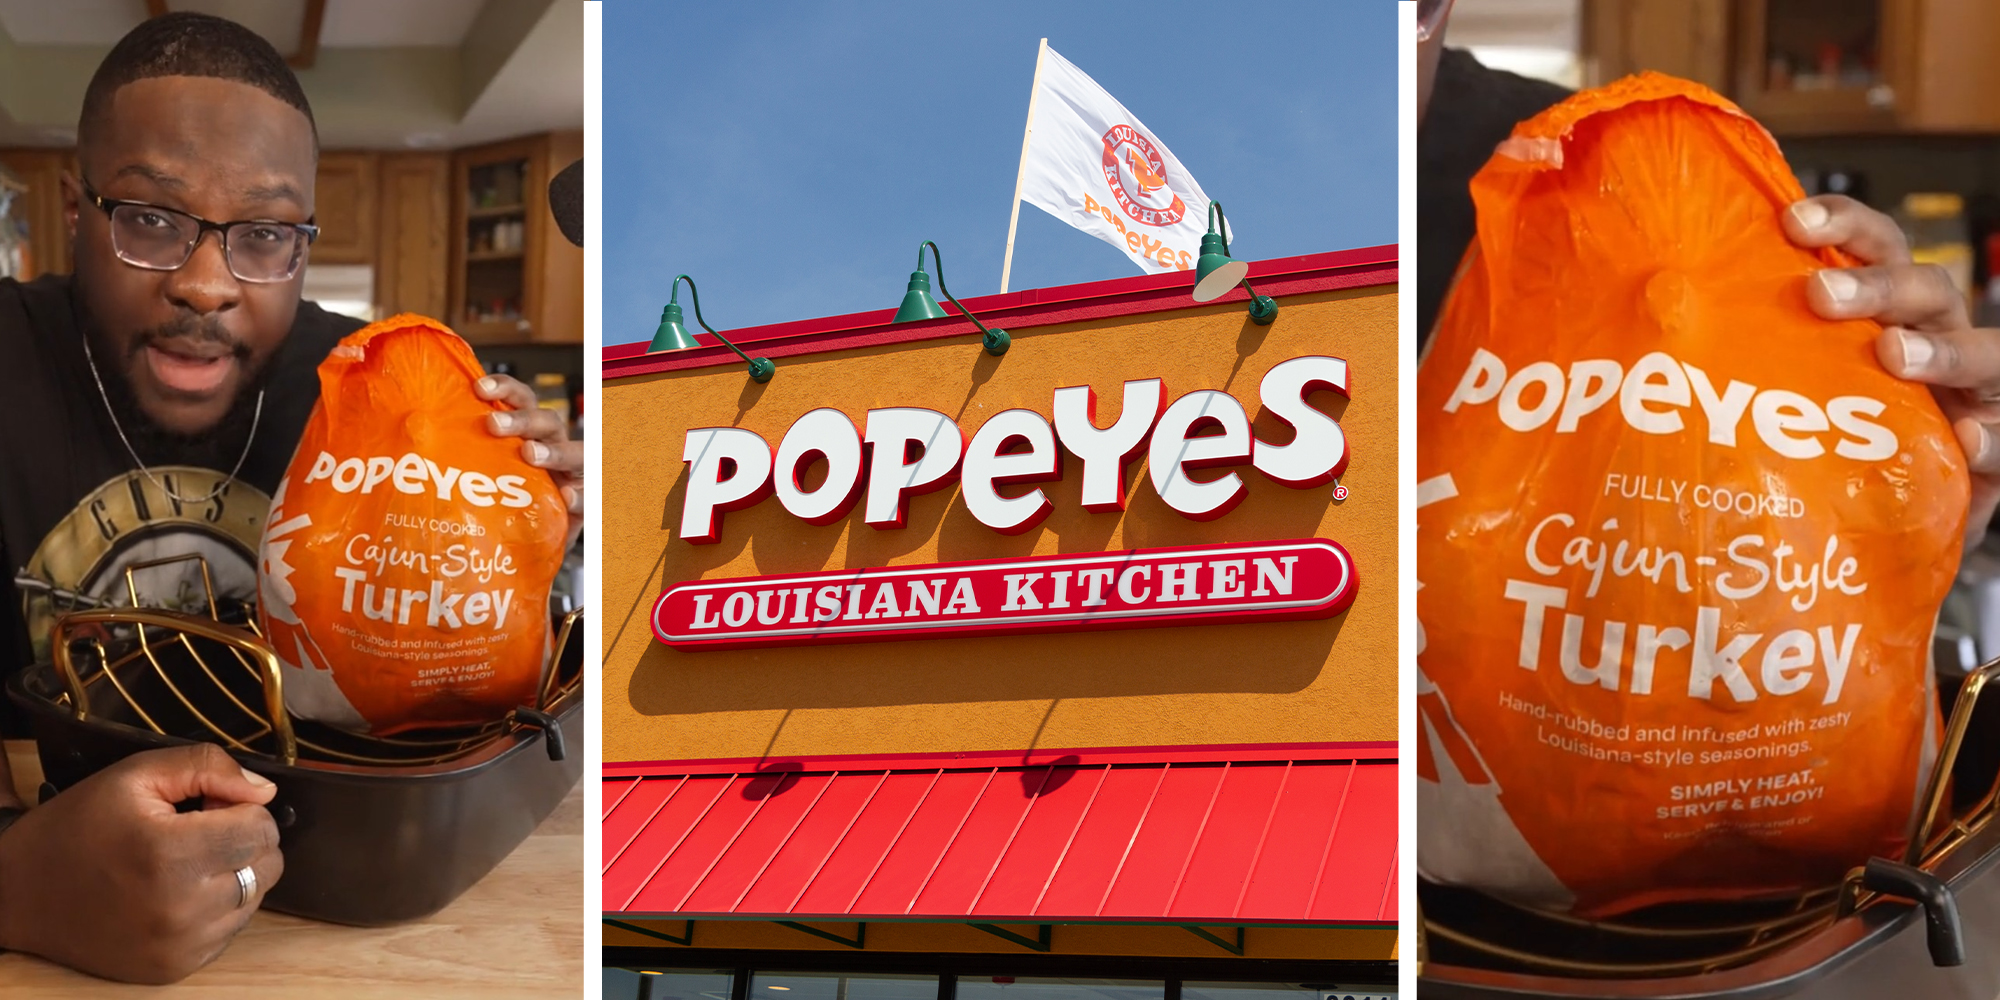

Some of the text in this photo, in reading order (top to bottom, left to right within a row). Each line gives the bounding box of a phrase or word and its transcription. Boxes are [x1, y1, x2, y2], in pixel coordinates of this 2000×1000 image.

[90, 474, 230, 541] GUNS
[1604, 473, 1805, 519] FULLY COOKED
[385, 513, 486, 537] FULLY COOKED
[345, 534, 517, 584] Cajun-Style
[1525, 512, 1867, 612] Cajun-Style
[335, 566, 514, 630] Turkey
[689, 555, 1300, 630] LOUISIANA KITCHEN
[332, 622, 398, 648] Hand-rubbed
[400, 636, 421, 649] and
[424, 638, 463, 649] infused
[465, 634, 486, 647] with
[352, 640, 430, 661] Louisiana-style
[1503, 579, 1863, 705] Turkey
[418, 666, 459, 678] SIMPLY
[458, 671, 495, 683] ENJOY!
[1499, 690, 1852, 745] Hand-rubbed and infused with zesty
[1538, 724, 1813, 768] Louisiana-style seasonings.
[1656, 786, 1824, 820] SERVE & ENJOY!
[1670, 769, 1815, 801] SIMPLY HEAT,
